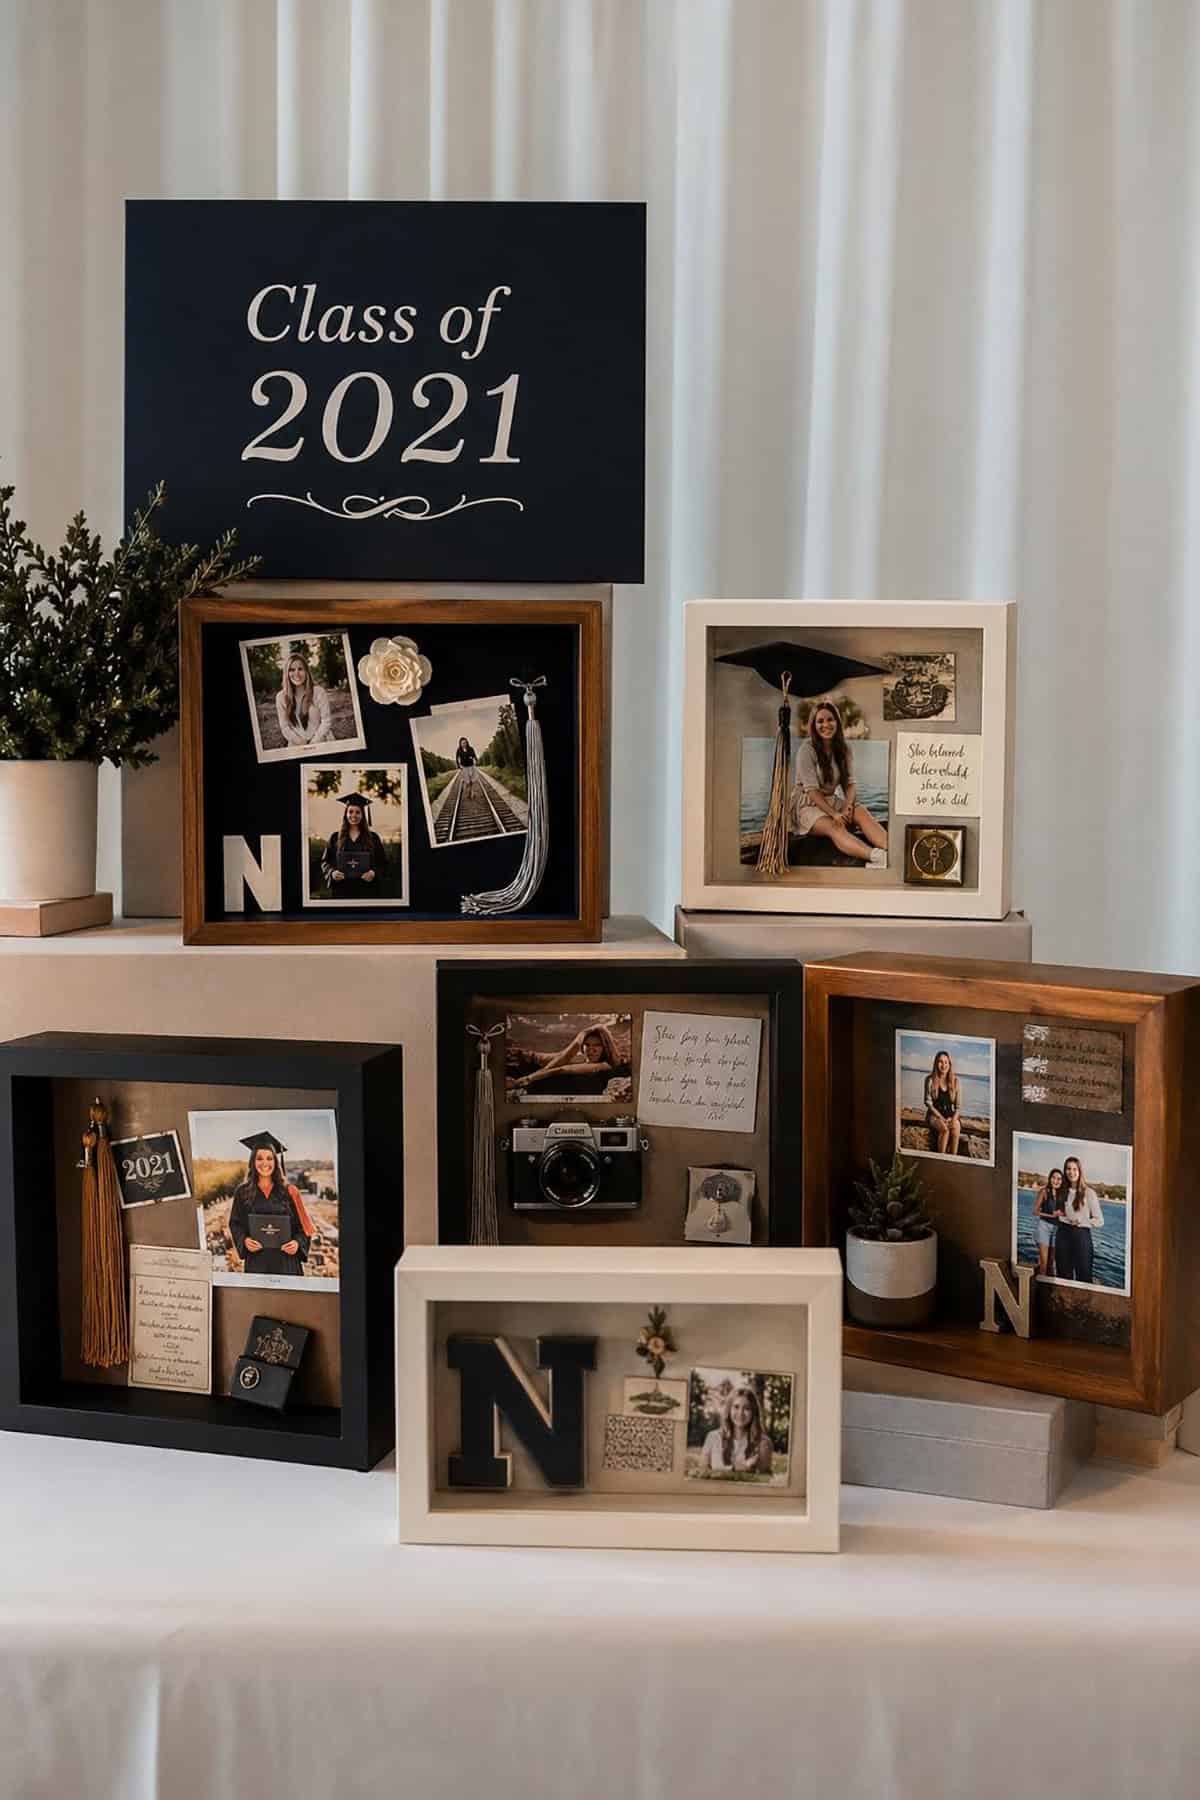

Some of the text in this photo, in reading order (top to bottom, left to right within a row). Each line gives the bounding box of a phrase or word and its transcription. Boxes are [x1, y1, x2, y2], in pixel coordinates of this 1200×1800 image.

[246, 283, 512, 360] Class of
[241, 370, 521, 463] 2021
[223, 835, 282, 912] N
[121, 1151, 175, 1181] 2021
[979, 1257, 1036, 1339] N
[447, 1335, 599, 1489] N
